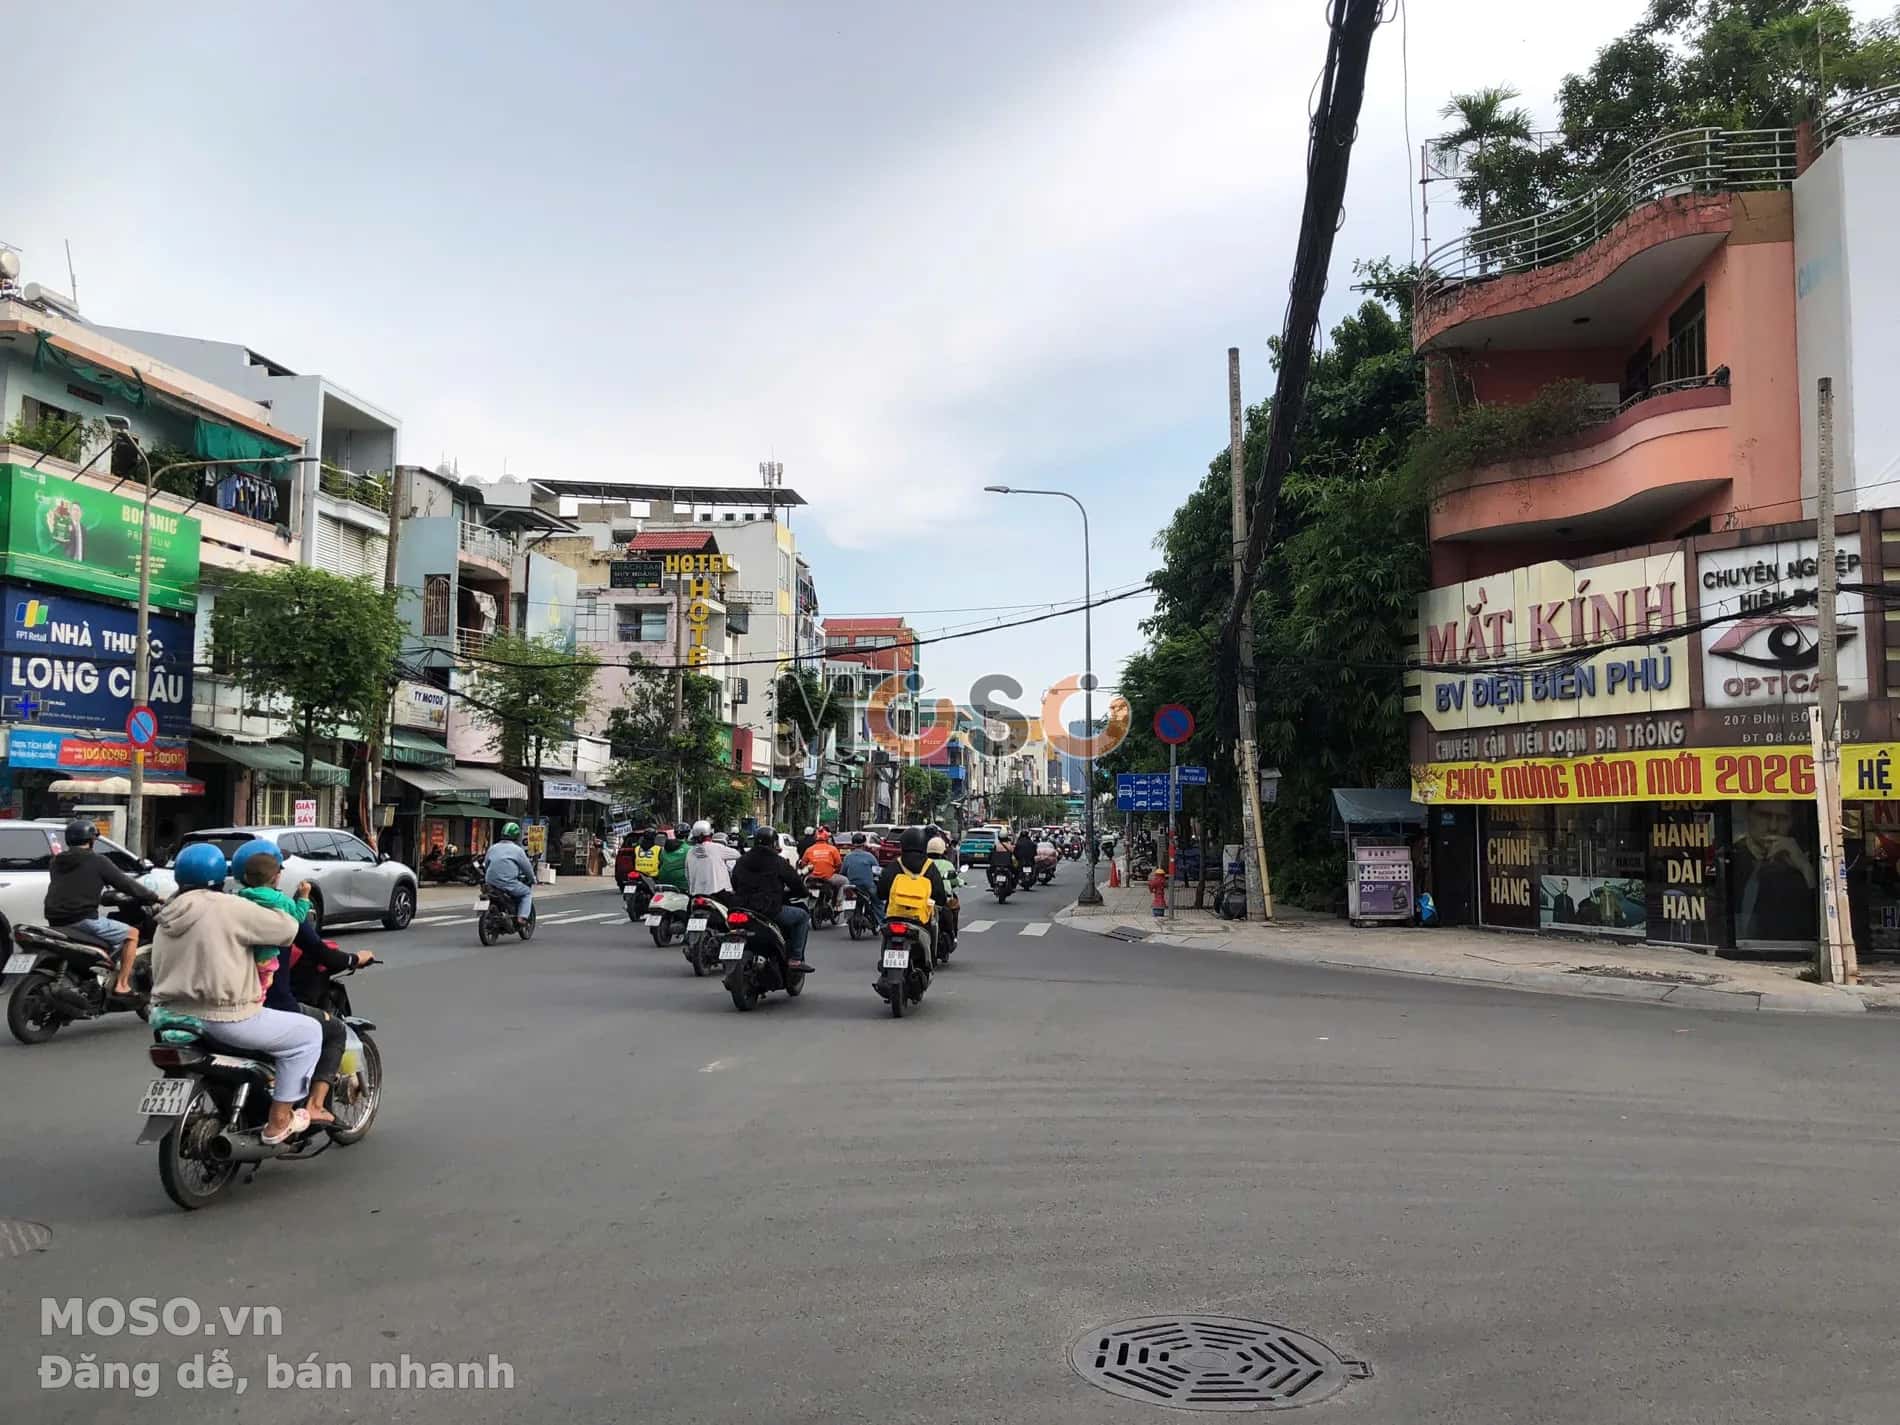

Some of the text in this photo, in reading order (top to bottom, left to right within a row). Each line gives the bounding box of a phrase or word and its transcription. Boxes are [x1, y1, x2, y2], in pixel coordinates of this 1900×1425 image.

[128, 530, 171, 548] PRIUM
[666, 553, 732, 573] HOTEL
[1703, 549, 1861, 589] CHUYÊN NGỆP
[688, 578, 710, 667] HOTE
[1529, 579, 1676, 652] KÍNH
[16, 631, 28, 641] FPT
[51, 621, 164, 659] NHÀ THUC
[11, 657, 100, 695] LONG
[1436, 680, 1466, 712] BV
[1472, 674, 1525, 714] ĐIỆN
[1607, 646, 1672, 695] PHỦ
[422, 692, 444, 705] MOTOR
[1724, 714, 1746, 727] 207
[1548, 728, 1588, 758] LOẠN
[1595, 726, 1616, 749] ĐA
[1446, 763, 1497, 800] CHÚC
[1715, 754, 1817, 795] 2026
[1858, 750, 1893, 797] HỆ
[1487, 831, 1530, 866] CHÍNH
[1653, 816, 1710, 848] HÀNH
[1667, 851, 1703, 883] DÀI
[1663, 895, 1706, 925] HẠN
